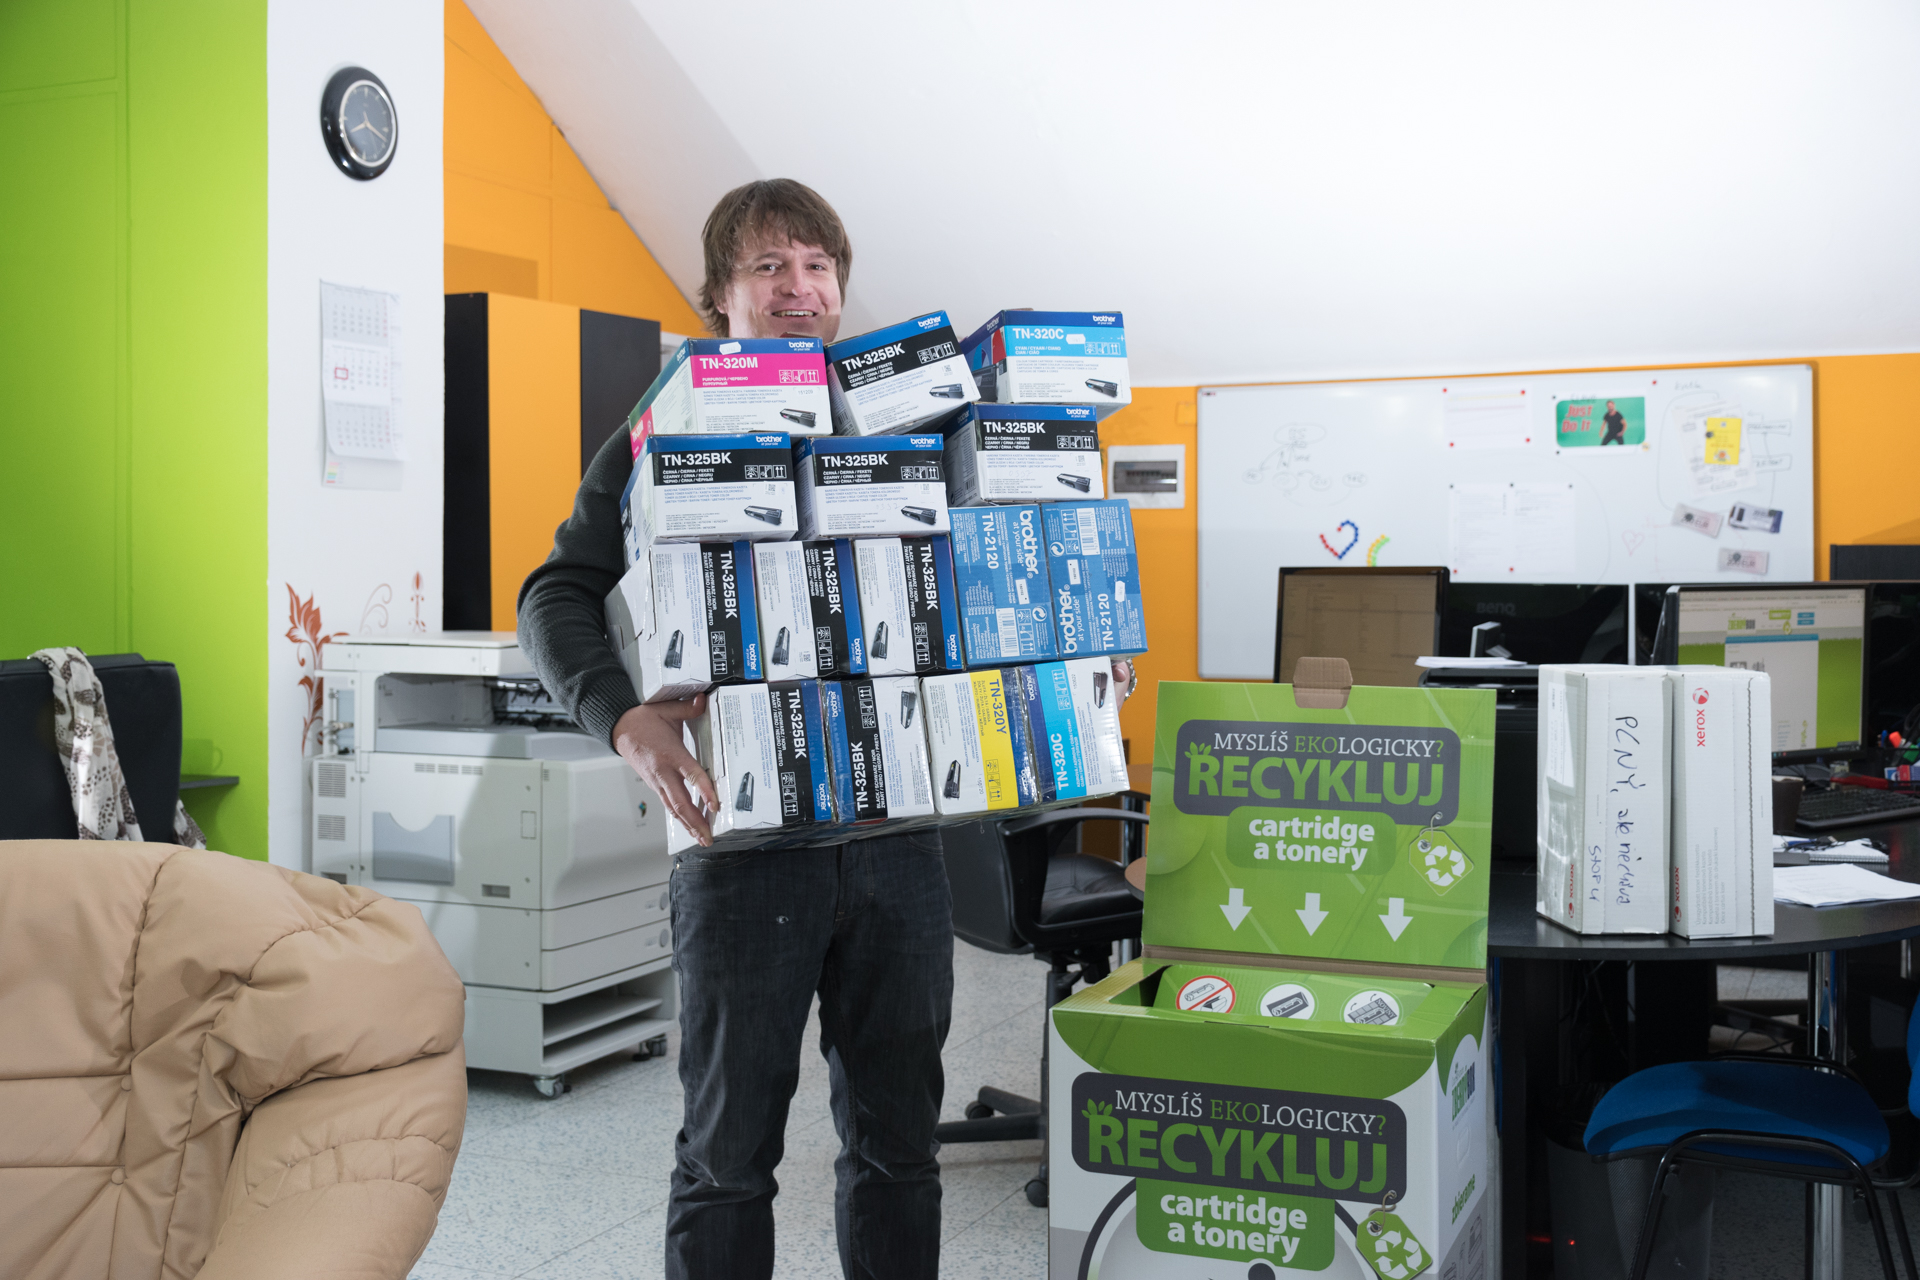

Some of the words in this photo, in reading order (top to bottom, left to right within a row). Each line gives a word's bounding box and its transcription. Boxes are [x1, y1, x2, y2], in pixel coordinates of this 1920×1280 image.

[918, 316, 942, 328] brother
[1012, 328, 1064, 339] TN-320C
[699, 357, 759, 370] TN-320M
[841, 343, 906, 372] TN-325BK
[756, 435, 782, 443] brother
[983, 421, 1046, 434] TN-325BK
[661, 452, 732, 467] TN-325BK
[821, 453, 889, 468] TN-325BK
[981, 512, 999, 569] TN-2120
[1013, 530, 1022, 548] your
[720, 550, 738, 619] TN-325BK
[822, 547, 842, 614] TN-325BK
[920, 544, 939, 611] TN-325BK
[1075, 615, 1084, 633] your
[1097, 593, 1115, 651] TN-2120
[854, 638, 862, 665] brother
[949, 633, 957, 661] brother
[1078, 634, 1084, 642] at
[749, 643, 757, 671] brother
[1026, 675, 1036, 701] brother
[830, 690, 838, 717] brother
[989, 679, 1007, 735] TN-320Y
[788, 689, 807, 759] TN-325BK
[1696, 709, 1706, 747] xerox
[1213, 731, 1289, 752] MYSLÍŠ
[1294, 735, 1445, 758] EKOLOGICKY?
[850, 741, 869, 811] TN-325BK
[1050, 733, 1069, 791] TN-320C
[1186, 755, 1445, 806] RECYKLUJ
[1248, 815, 1375, 847] cartridge
[1253, 842, 1270, 860] a
[1275, 840, 1368, 871] tonery
[1114, 1089, 1203, 1118] MYSLÍŠ
[1209, 1098, 1387, 1136] EKOLOGICKY?
[1087, 1114, 1388, 1195] RECYKLUJ
[1160, 1193, 1308, 1235] cartridge
[1168, 1223, 1186, 1243] a
[1192, 1219, 1300, 1263] tonery
